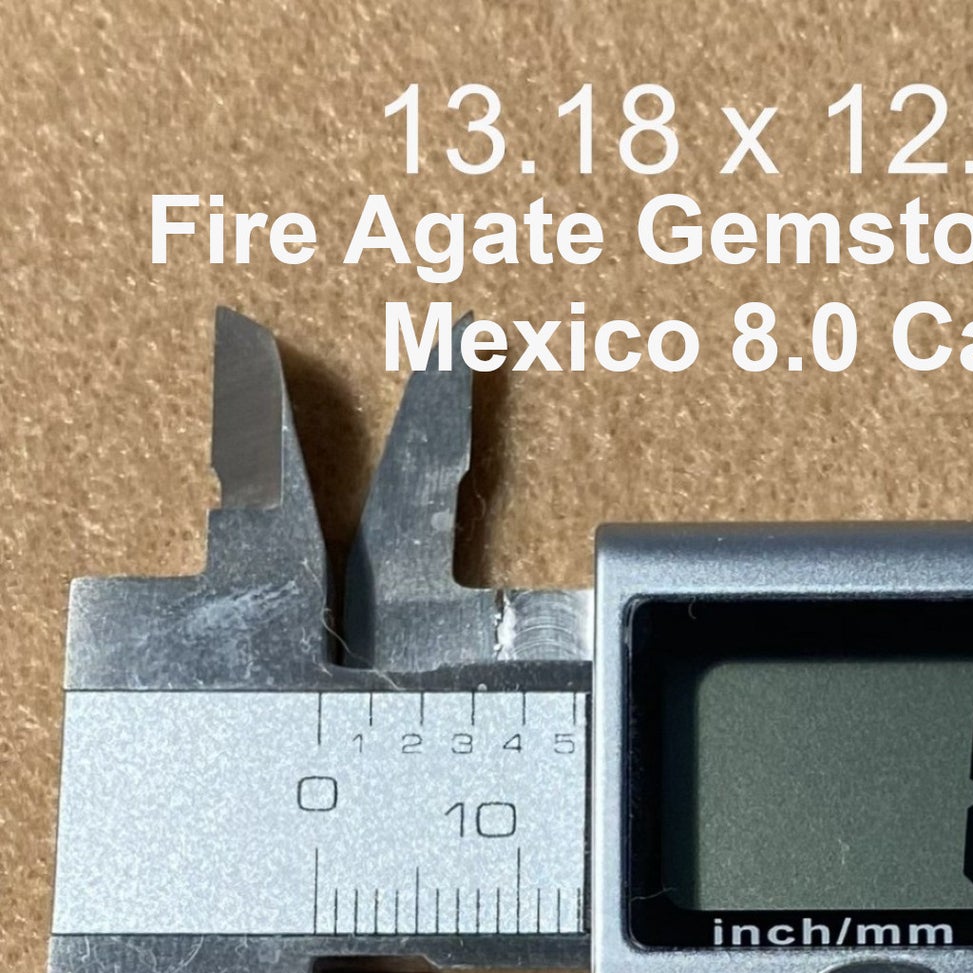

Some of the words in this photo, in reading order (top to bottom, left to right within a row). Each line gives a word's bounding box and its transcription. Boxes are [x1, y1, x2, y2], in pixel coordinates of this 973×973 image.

[351, 732, 364, 755] 1
[401, 732, 424, 755] 2
[450, 732, 474, 755] 3
[502, 732, 523, 755] 4
[553, 732, 576, 755] 5
[444, 801, 518, 839] 10
[712, 916, 954, 946] inch/mm
